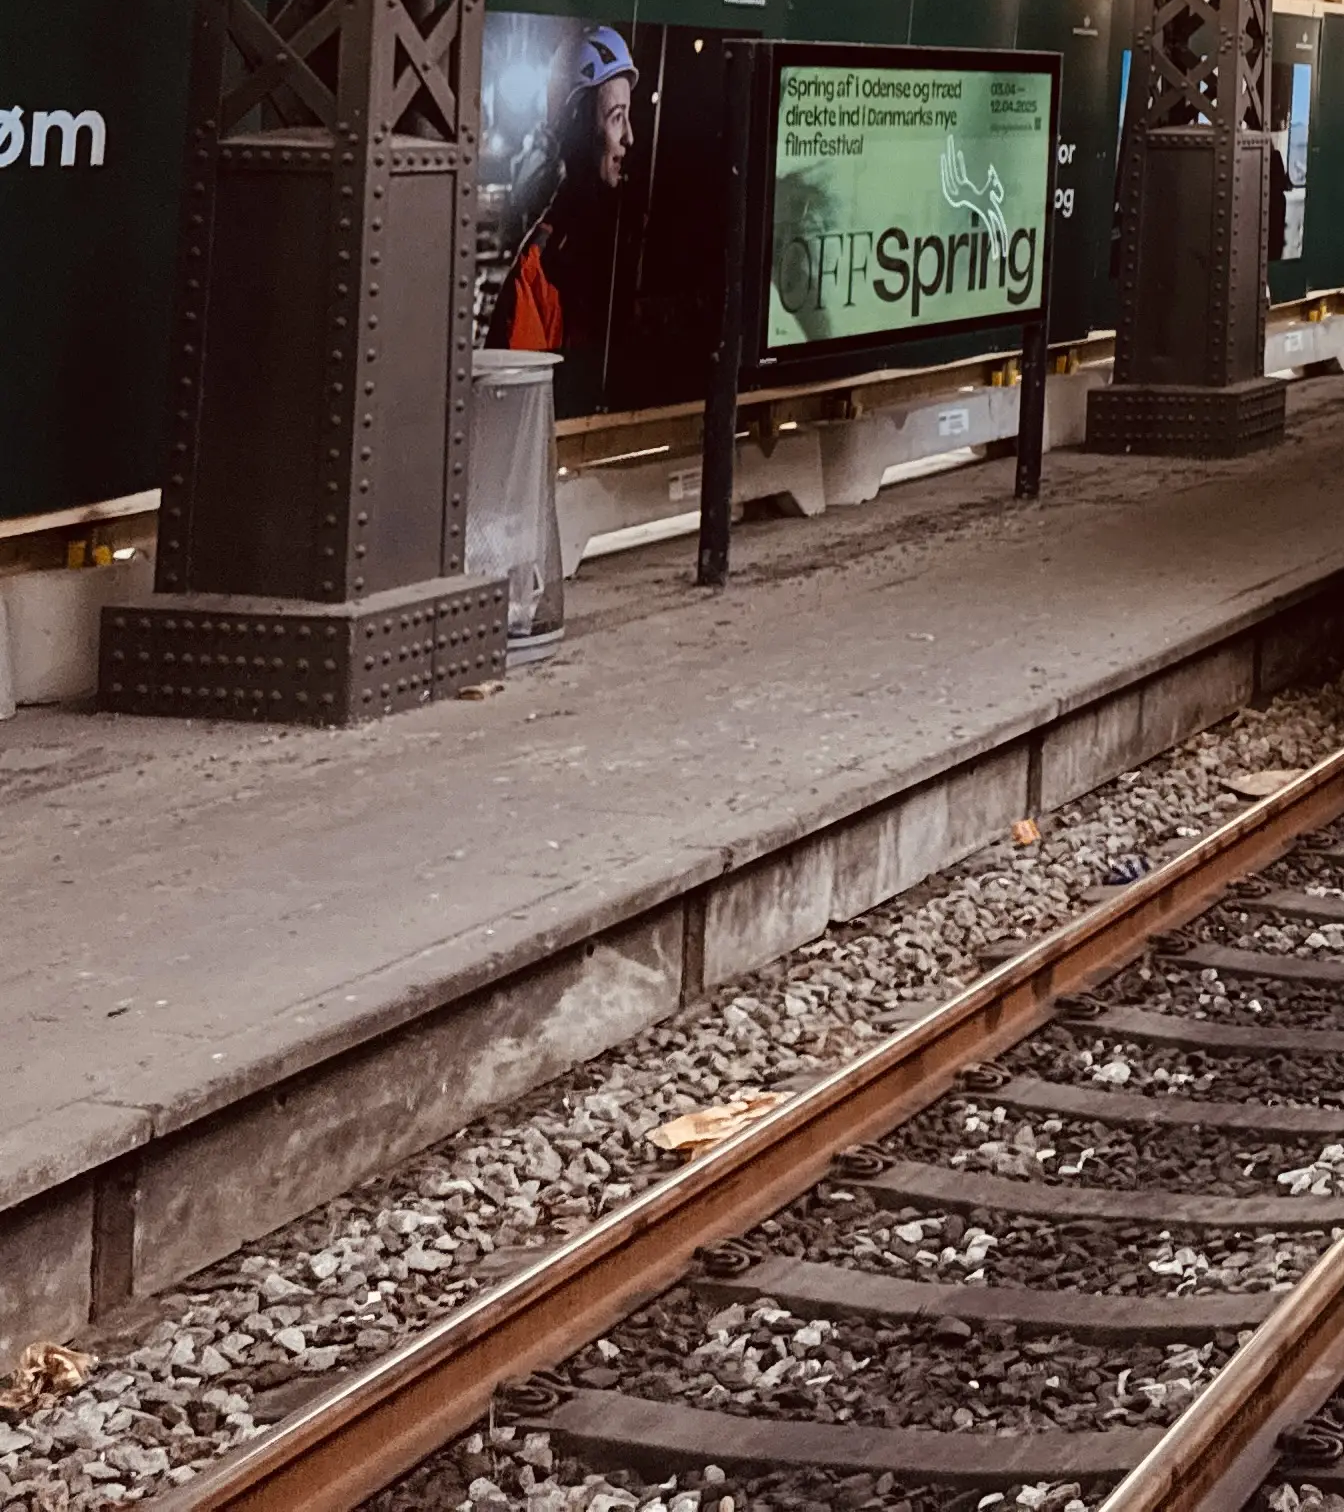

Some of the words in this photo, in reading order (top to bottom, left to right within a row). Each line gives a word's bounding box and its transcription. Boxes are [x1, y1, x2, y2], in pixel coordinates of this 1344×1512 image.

[787, 76, 835, 102] Spring
[836, 73, 853, 98] af
[862, 79, 911, 99] Odense
[912, 83, 930, 104] og
[932, 80, 962, 100] træd
[786, 105, 836, 127] direkte
[838, 105, 860, 127] ind
[867, 107, 933, 127] Danmarks
[934, 111, 957, 131] nye
[785, 132, 864, 157] filmfestival
[1057, 134, 1076, 165] or
